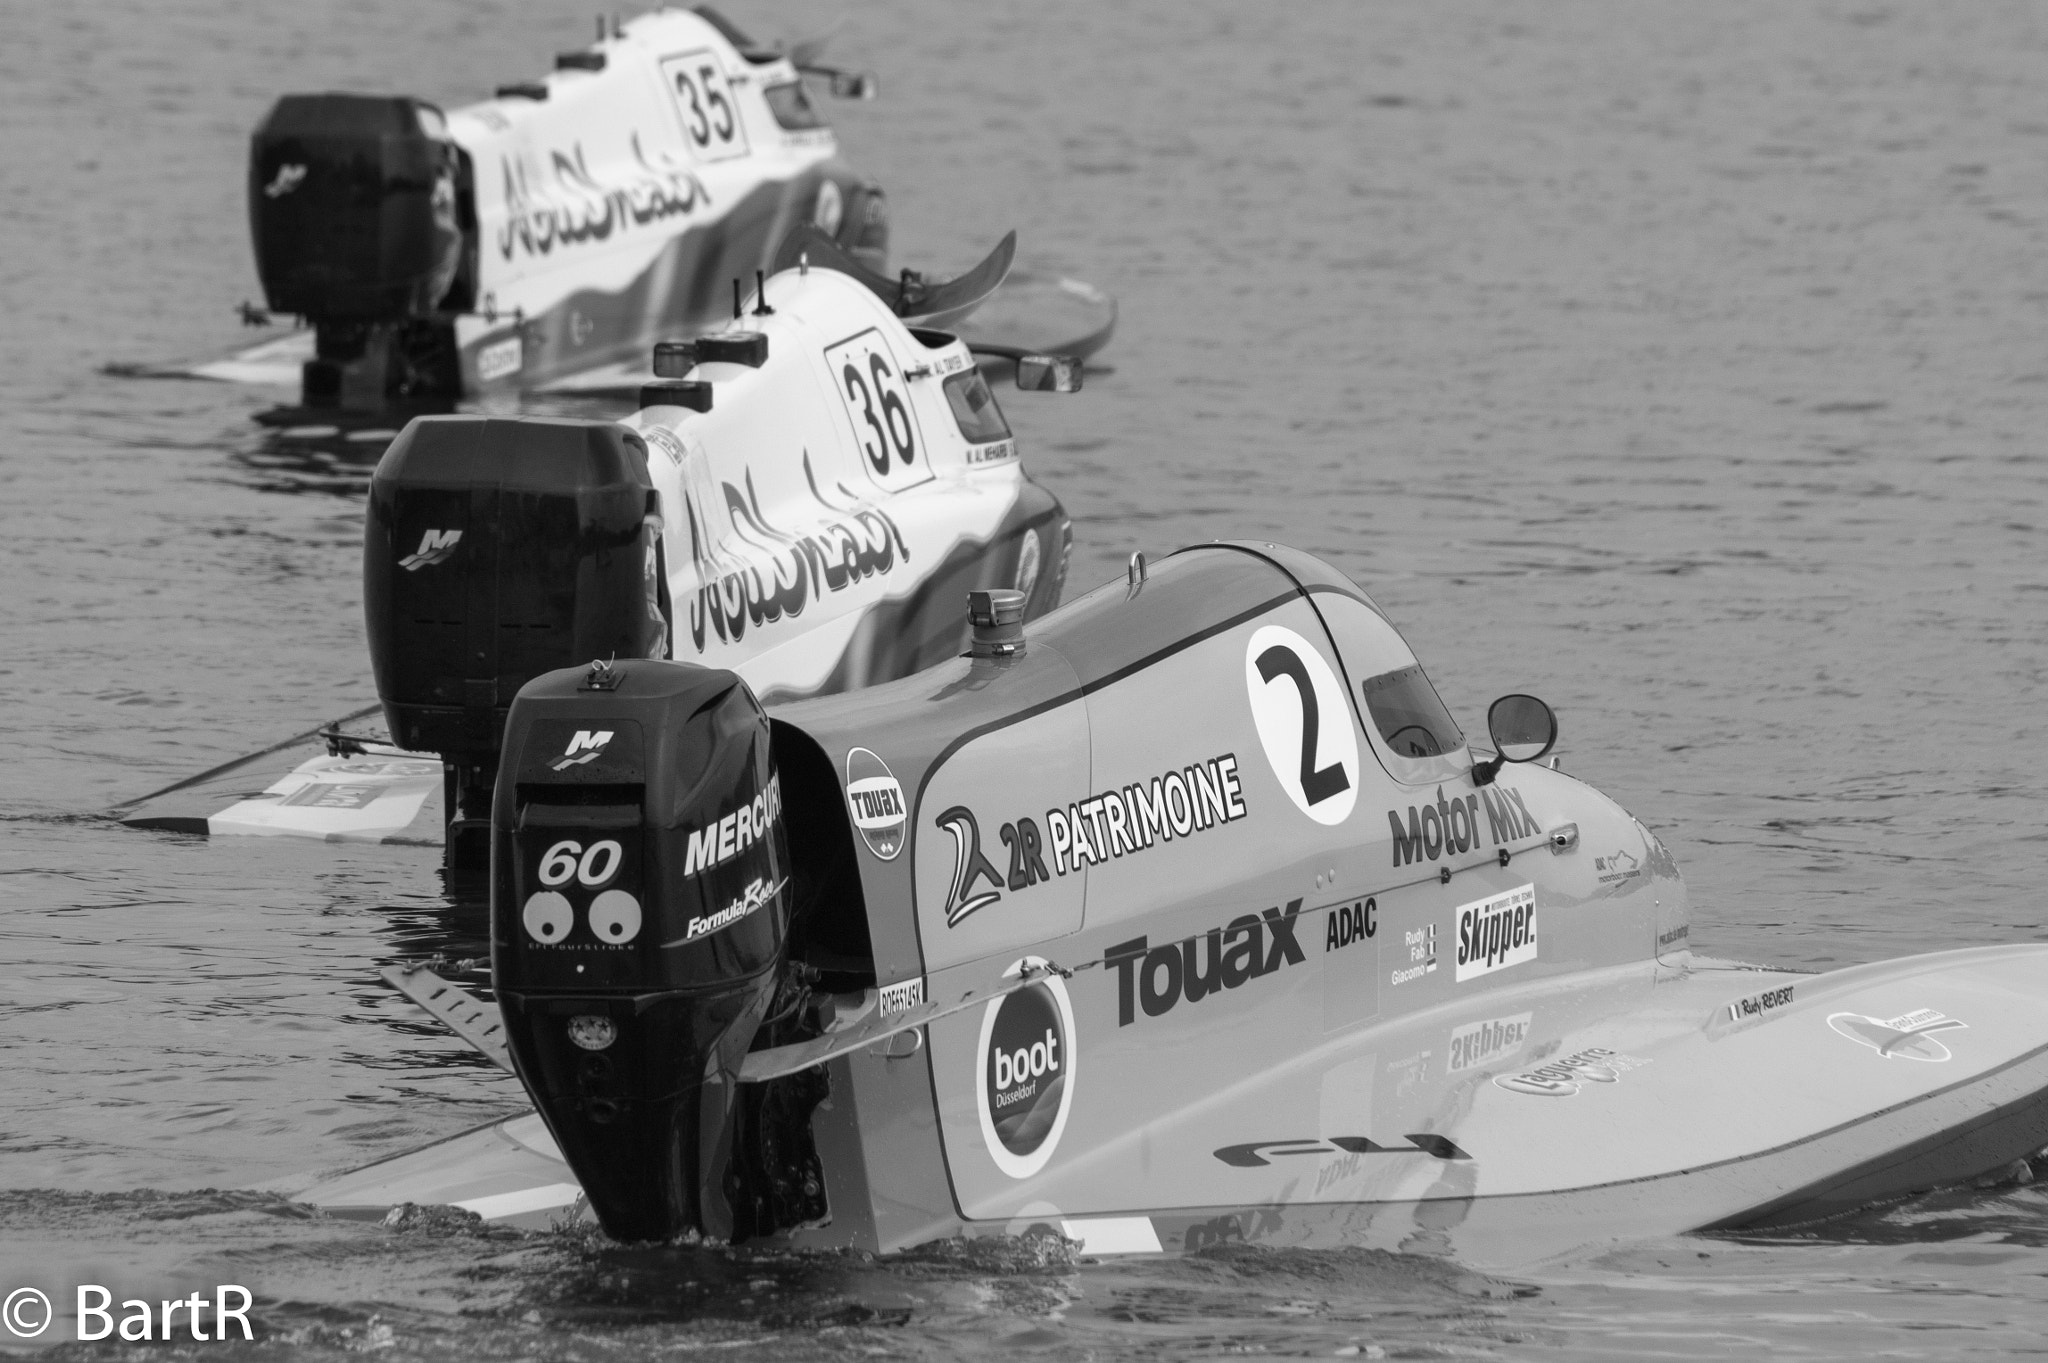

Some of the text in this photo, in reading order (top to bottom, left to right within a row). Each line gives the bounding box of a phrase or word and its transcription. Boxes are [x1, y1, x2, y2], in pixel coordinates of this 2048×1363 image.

[676, 66, 734, 149] 35
[844, 352, 915, 476] 36
[1254, 645, 1351, 806] 2
[1000, 753, 1246, 892] 2R PATRIMOINE
[538, 839, 623, 888] 60
[1326, 897, 1378, 952] ADAC
[1405, 927, 1425, 946] Rudy
[1411, 944, 1425, 962] Fab
[1458, 902, 1535, 968] Skipper.
[1104, 897, 1307, 1028] Touax
[1391, 964, 1425, 985] Giacomo
[1741, 986, 1795, 1017] Rudy REVERT
[994, 1028, 1059, 1090] boot
[996, 1079, 1037, 1109] Düsseldorf
